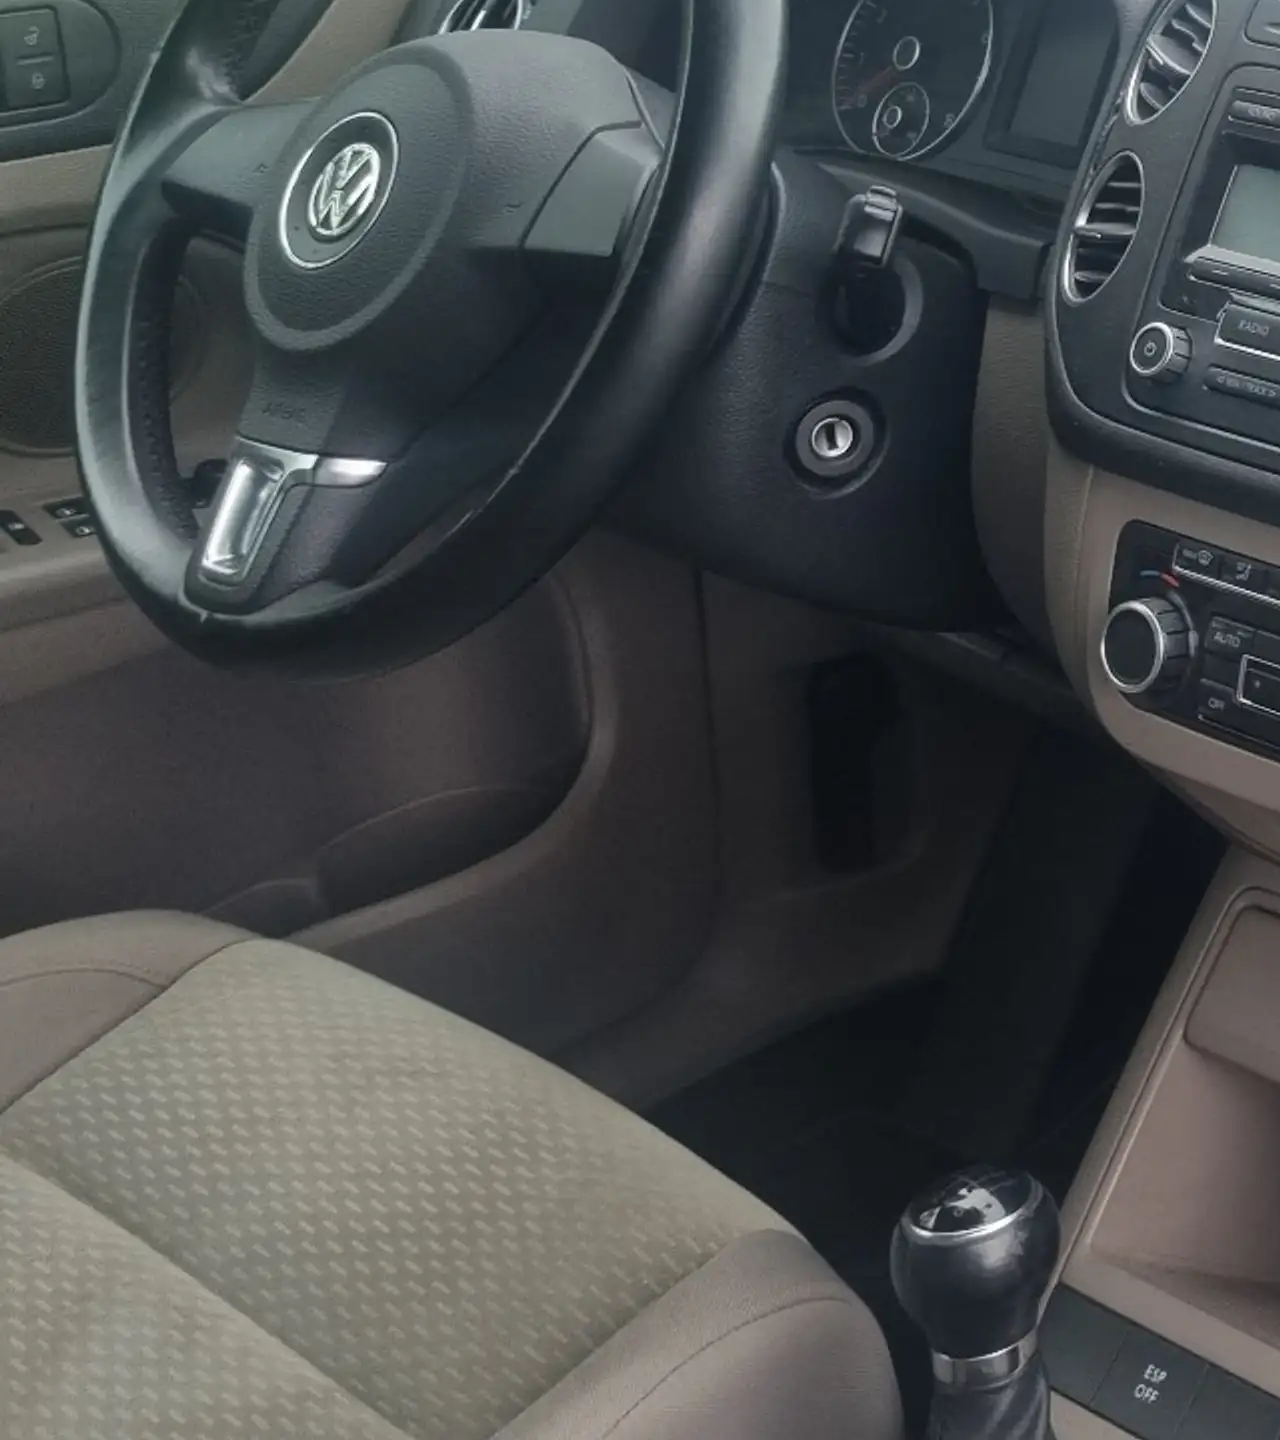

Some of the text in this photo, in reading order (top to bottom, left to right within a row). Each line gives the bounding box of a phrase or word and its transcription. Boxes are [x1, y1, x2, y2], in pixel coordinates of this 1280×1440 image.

[1238, 319, 1270, 337] RADIO
[1213, 631, 1241, 649] AUTO
[1143, 1363, 1168, 1385] ESP
[1133, 1383, 1160, 1405] OFF
